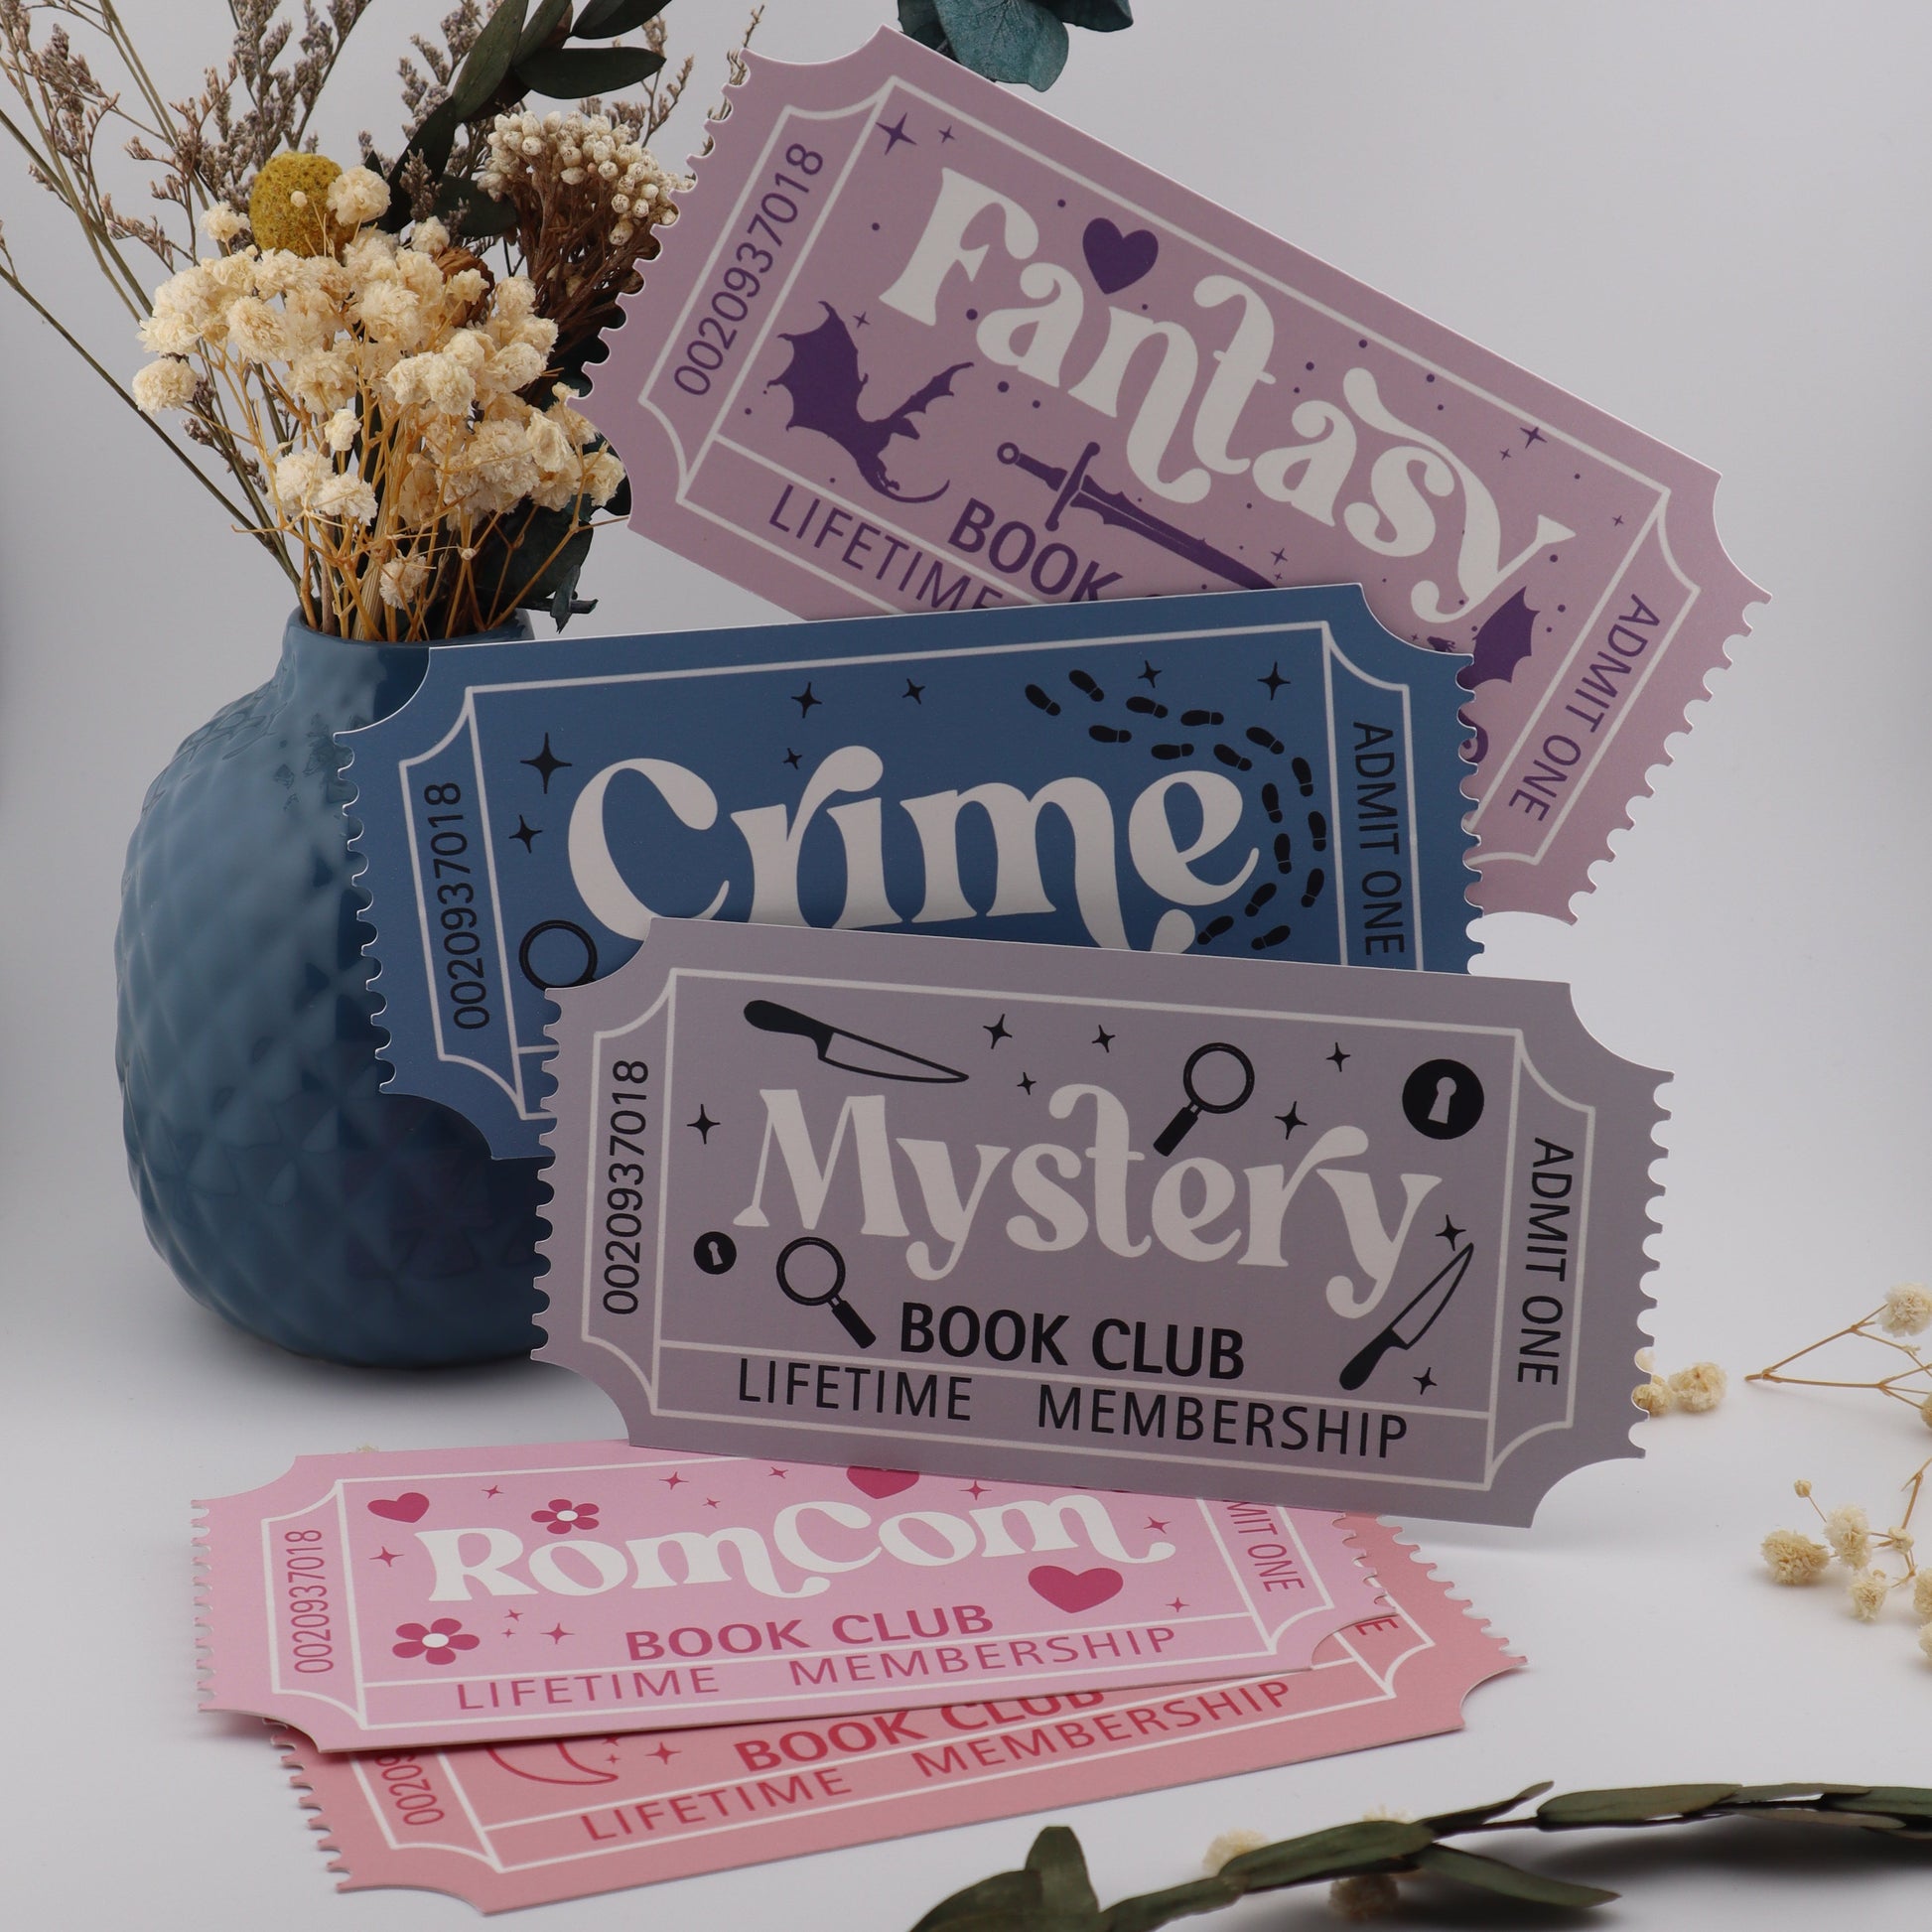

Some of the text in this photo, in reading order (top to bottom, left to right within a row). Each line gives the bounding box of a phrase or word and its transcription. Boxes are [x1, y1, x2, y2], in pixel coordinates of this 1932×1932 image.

[673, 143, 824, 396] 0020937018
[879, 167, 1577, 623] Fantasy
[947, 496, 1124, 604] BOOK
[1508, 593, 1662, 823] ADMIT ONE
[423, 781, 491, 1030] 0020937018
[568, 745, 1261, 955] Crime
[1352, 721, 1405, 957] ADMIT ONE
[602, 1059, 649, 1315] 0020937018
[733, 1082, 1444, 1320] Mystery
[1517, 1137, 1576, 1386] ADMIT ONE
[738, 1357, 1409, 1459] LIFETIME MEMBERSHIP
[899, 1302, 1246, 1381] BOOK CLUB
[284, 1529, 335, 1675] 0020937018
[414, 1494, 1177, 1603] RomCom
[1222, 1500, 1306, 1592] MIT ONE
[456, 1627, 1175, 1711] LIFETIME MEMBERSHIP
[624, 1604, 994, 1662] BOOK CLUB
[581, 1681, 1290, 1843] LIFETIME MEMBERSHIP
[734, 1711, 928, 1773] BOOK
